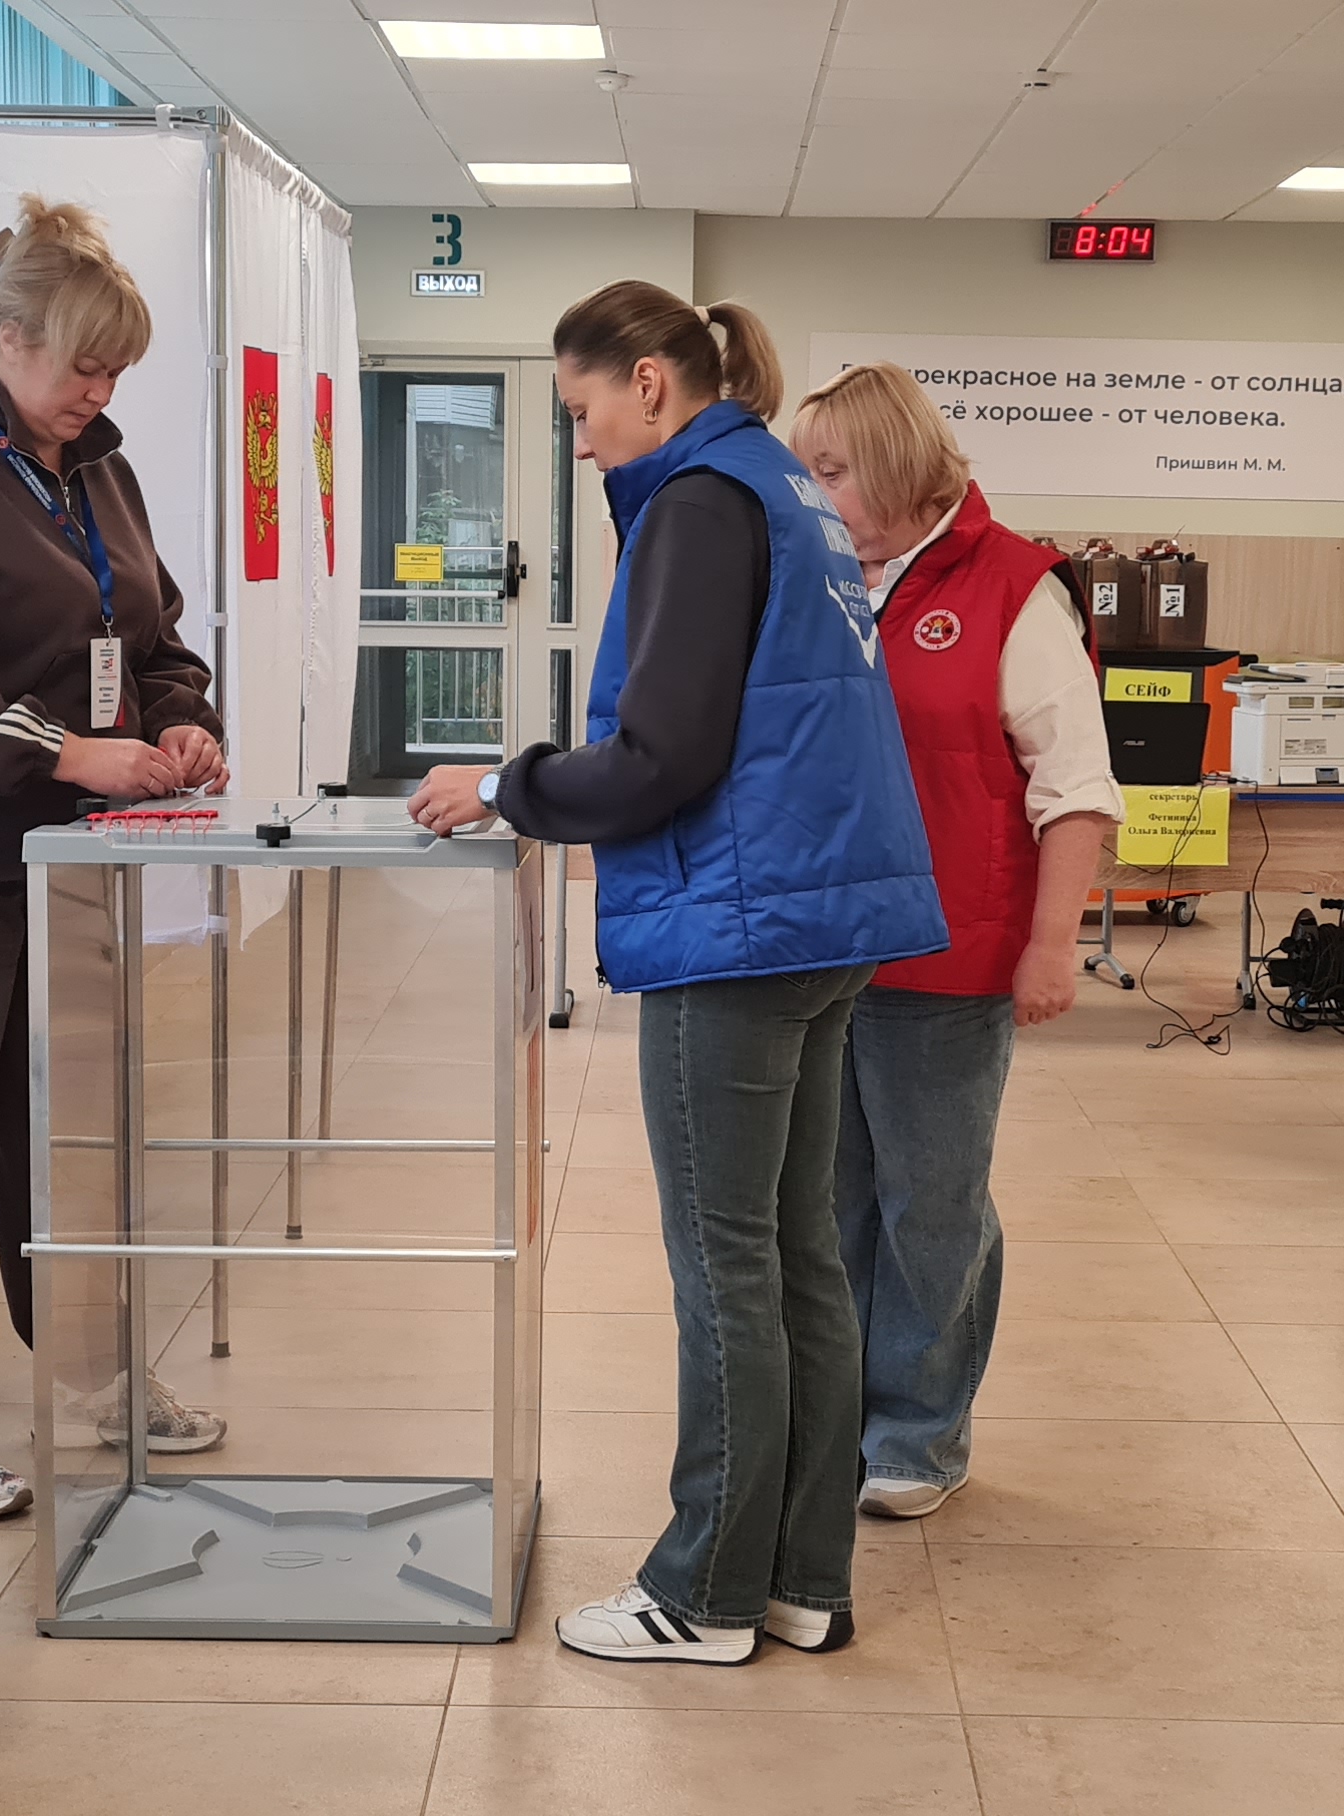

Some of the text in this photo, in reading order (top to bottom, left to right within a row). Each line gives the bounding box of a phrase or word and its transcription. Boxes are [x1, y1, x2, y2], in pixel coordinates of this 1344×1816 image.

[1075, 226, 1152, 254] 8:04
[418, 275, 478, 291] ВЫХОД
[907, 368, 1056, 389] рекрасное
[1066, 372, 1096, 388] на
[1104, 372, 1186, 390] земле
[1210, 375, 1240, 391] от
[939, 399, 967, 420] сё
[975, 405, 1093, 425] хорошее
[1118, 408, 1147, 423] от
[1154, 409, 1285, 427] человека.
[1156, 456, 1286, 471] Пришвин М. М.
[1098, 584, 1113, 615] №2
[1165, 587, 1180, 617] №1
[1125, 682, 1171, 697] СЕЙФ
[1149, 793, 1199, 803] секретарь
[1128, 826, 1158, 835] Ольга
